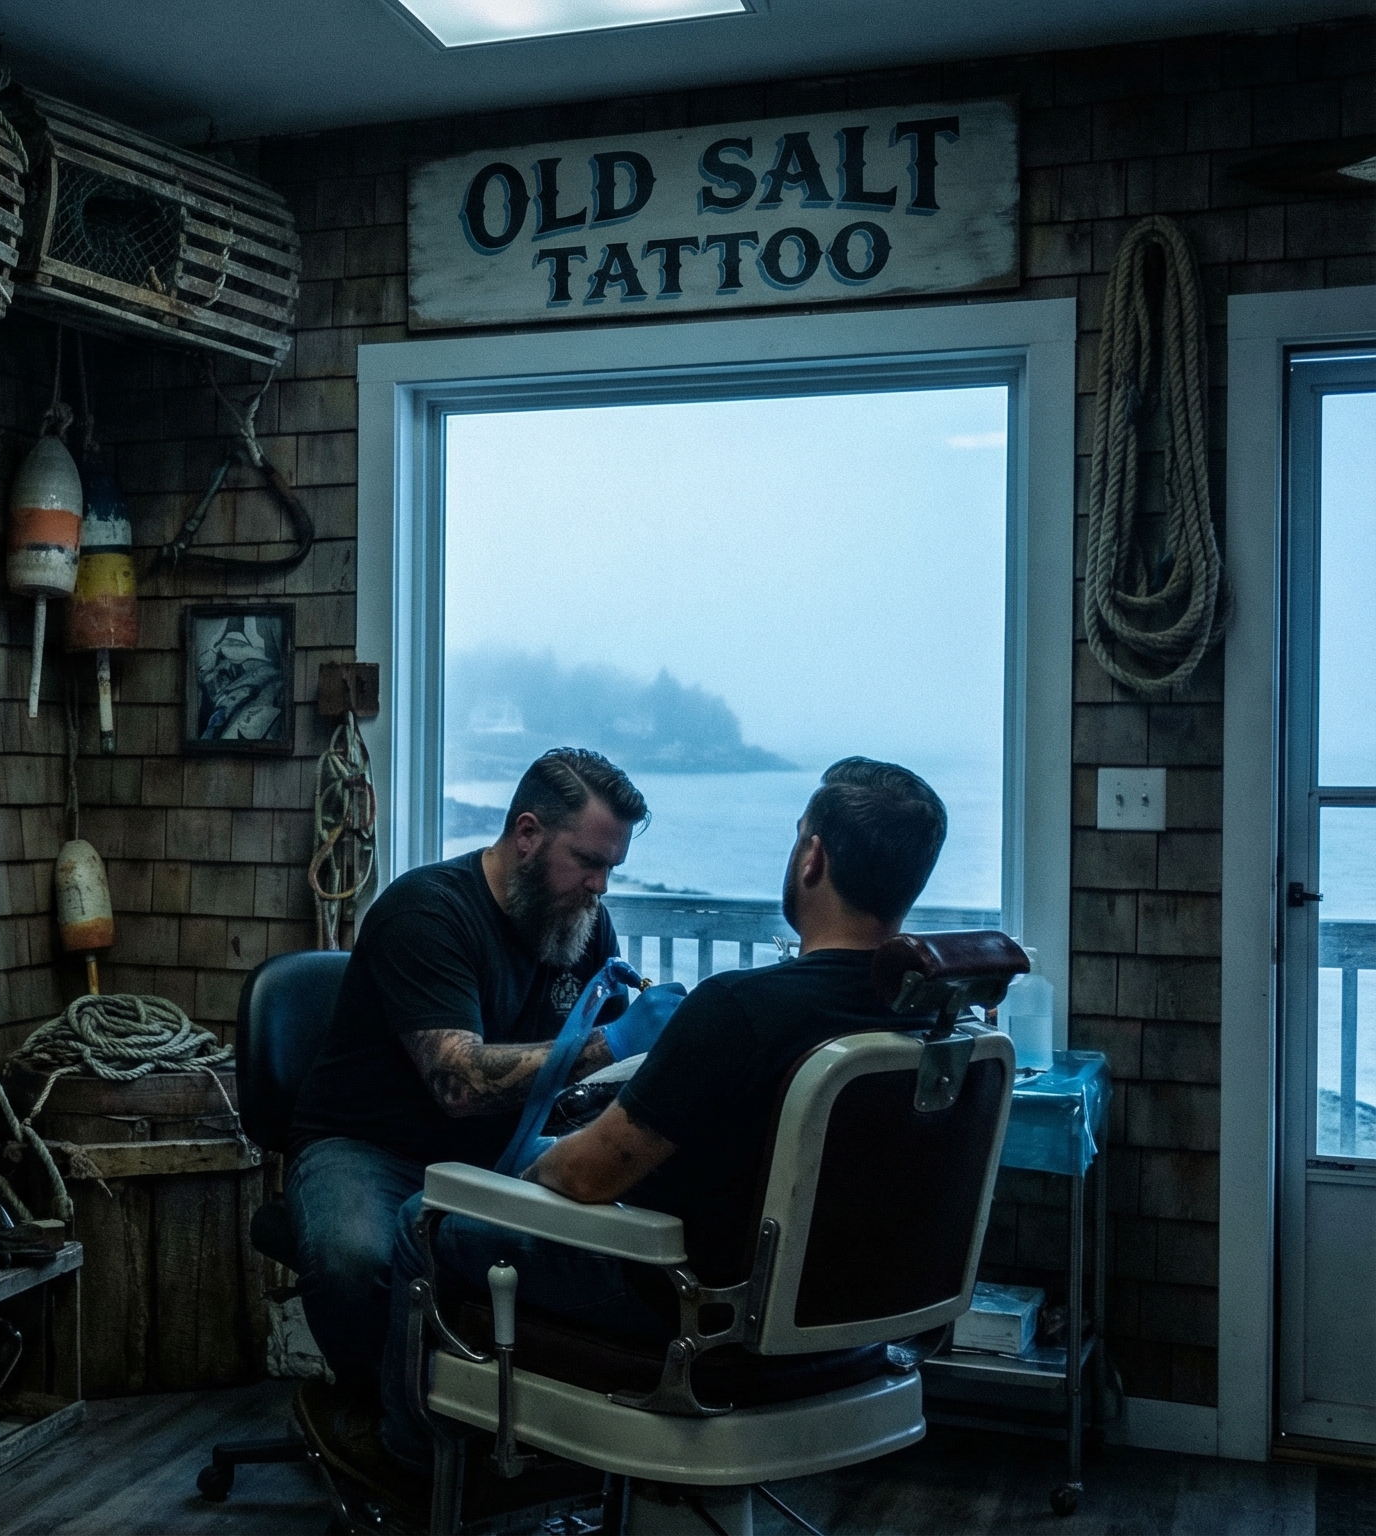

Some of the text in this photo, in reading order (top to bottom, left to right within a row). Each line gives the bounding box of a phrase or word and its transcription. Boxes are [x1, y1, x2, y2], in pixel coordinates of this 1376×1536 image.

[460, 115, 961, 257] OLD SALT
[532, 220, 893, 308] TATTOO
